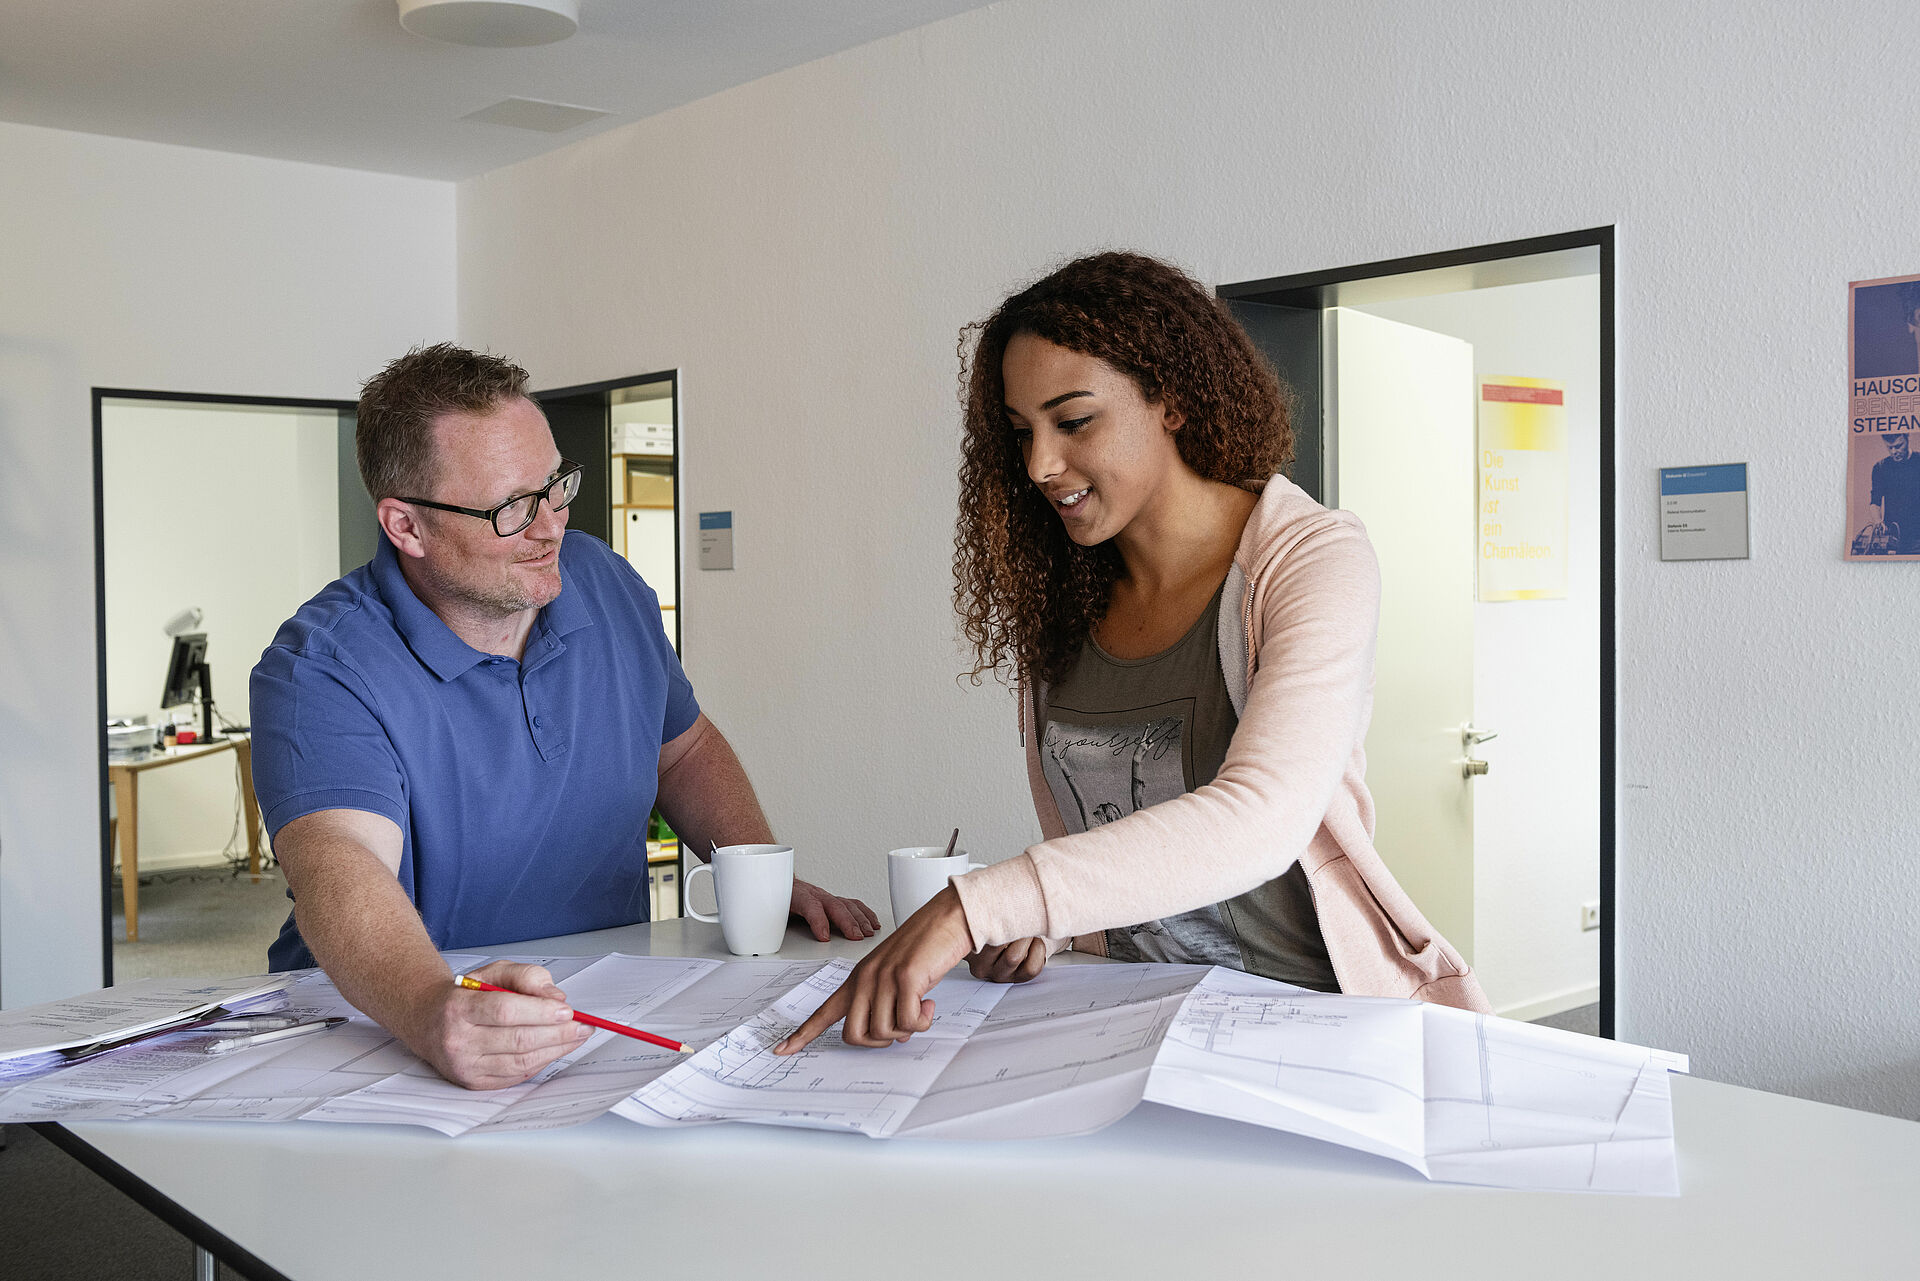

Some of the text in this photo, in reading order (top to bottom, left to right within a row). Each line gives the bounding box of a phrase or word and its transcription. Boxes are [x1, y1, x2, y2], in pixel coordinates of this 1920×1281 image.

[1854, 377, 1920, 396] HAUSC
[1483, 450, 1504, 468] Die
[1484, 474, 1520, 492] Kunst
[1483, 499, 1500, 514] ist
[1483, 518, 1502, 537] ein
[1058, 716, 1184, 760] yourself
